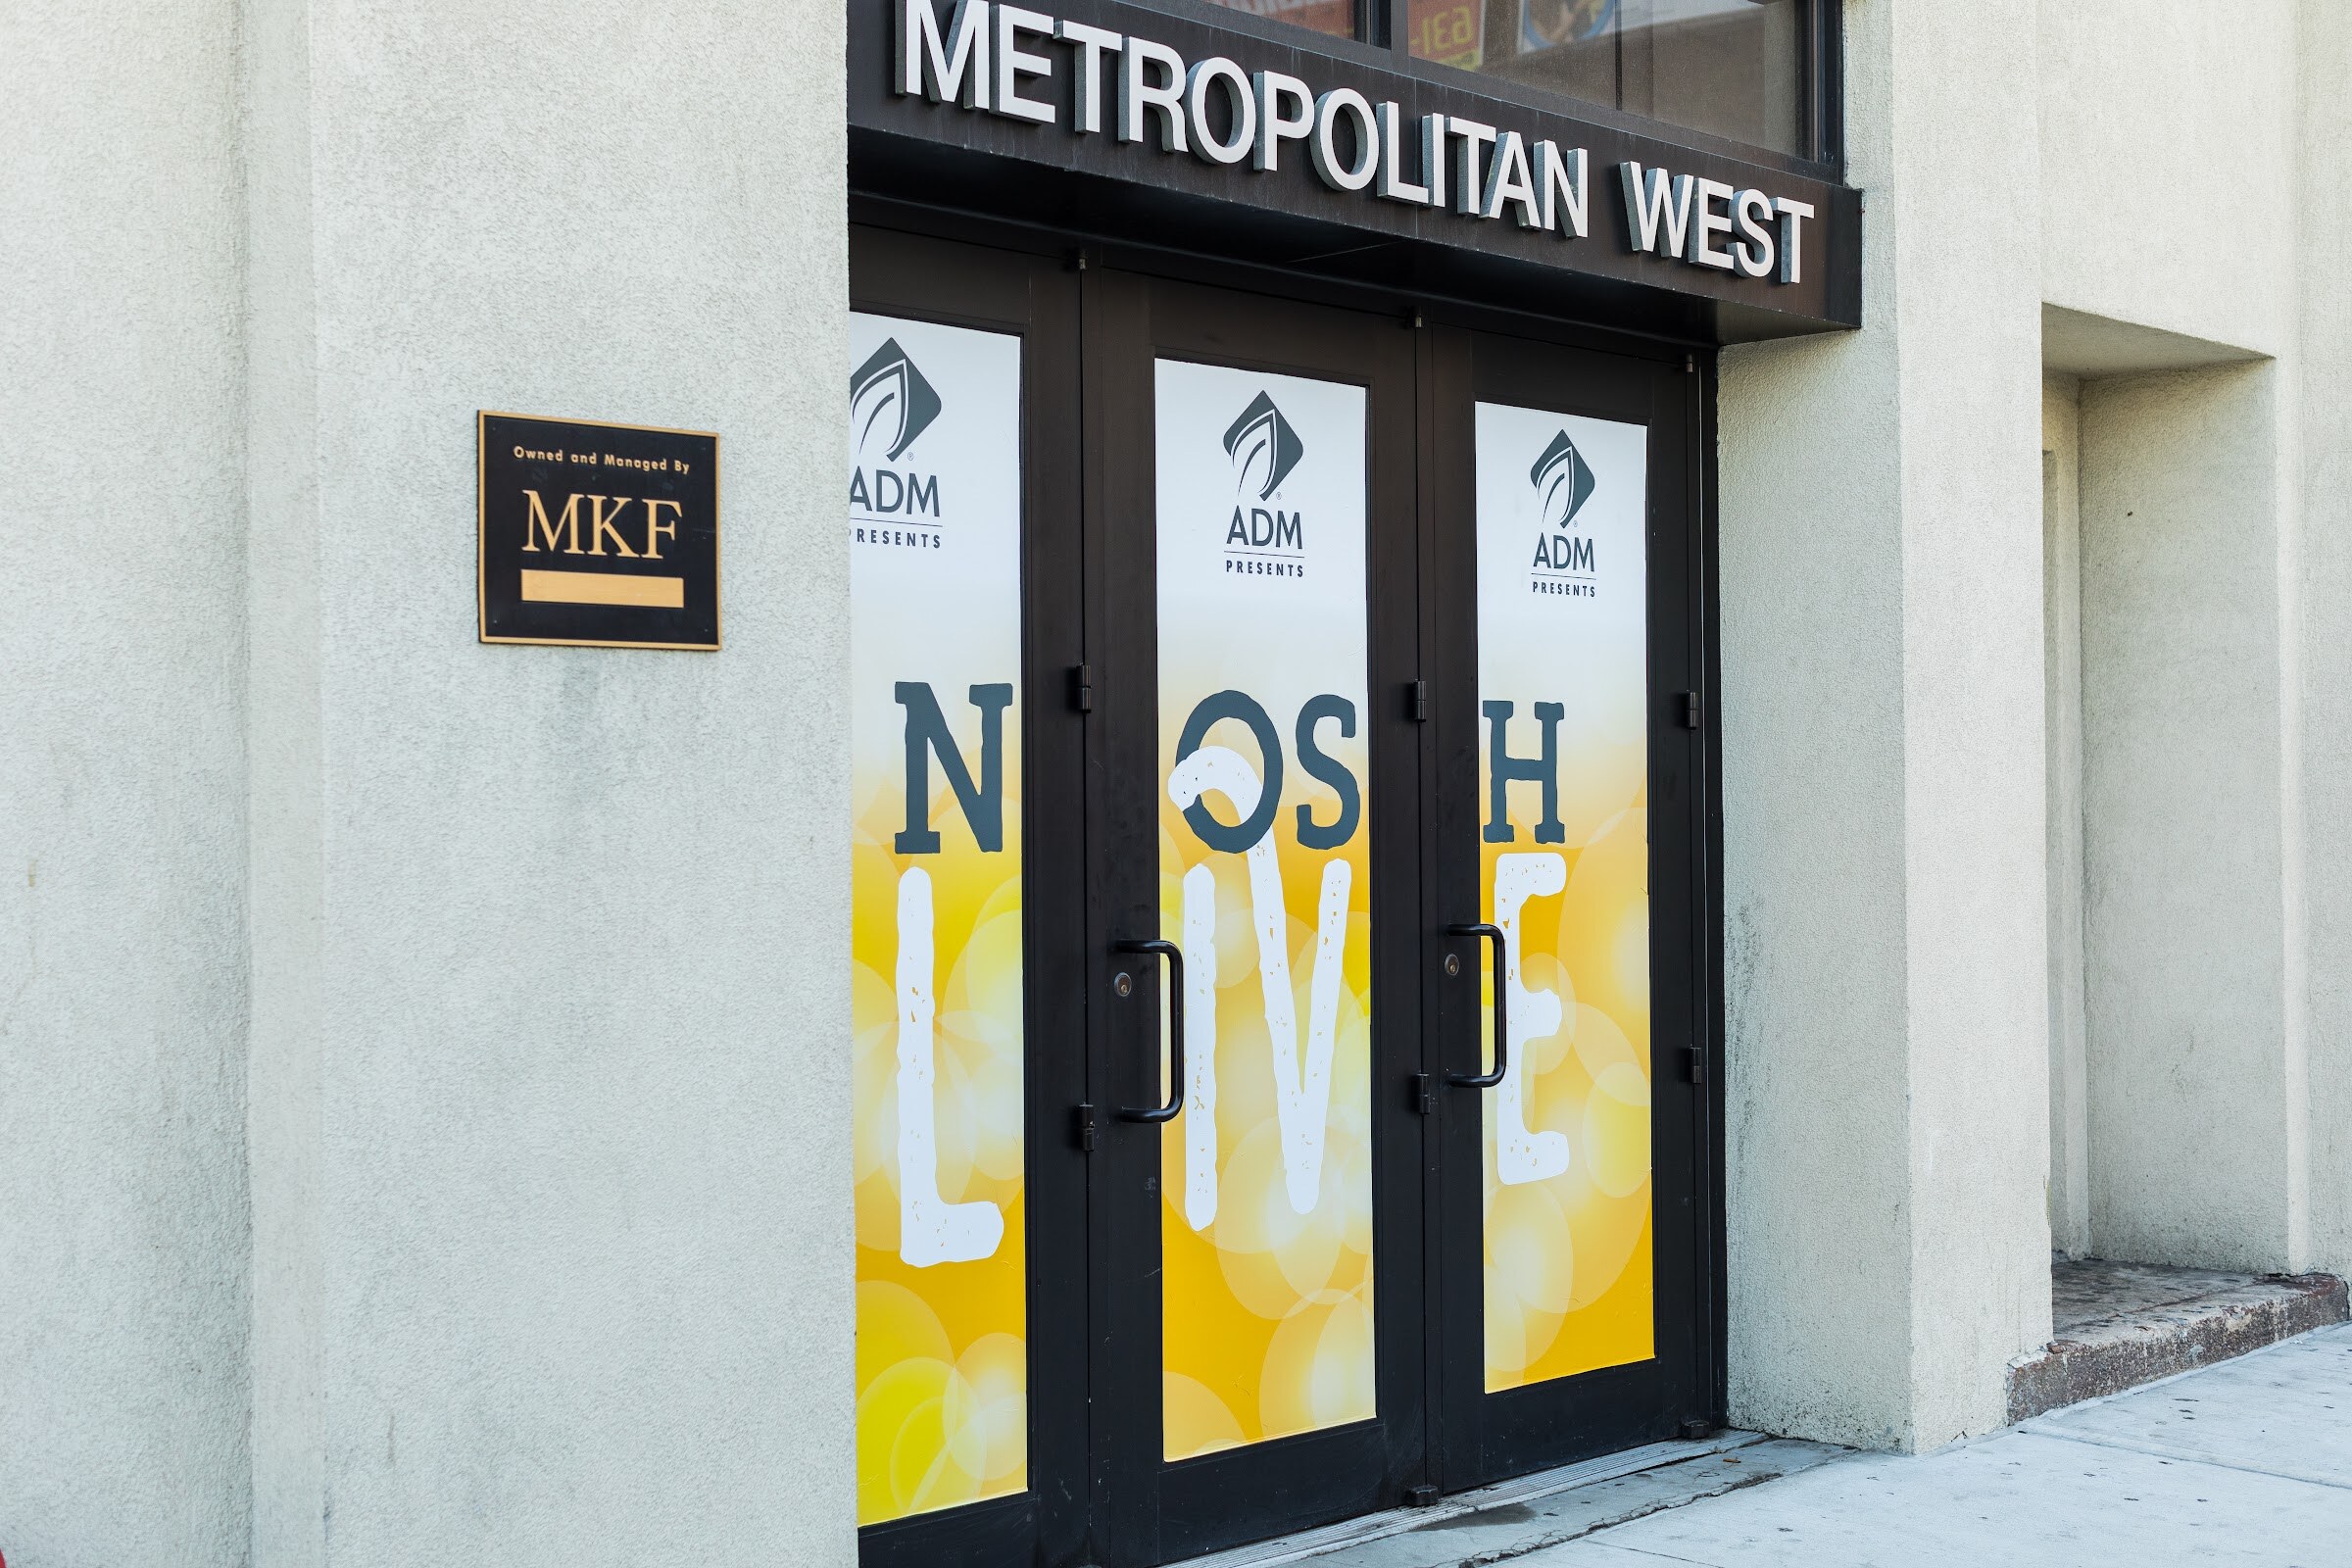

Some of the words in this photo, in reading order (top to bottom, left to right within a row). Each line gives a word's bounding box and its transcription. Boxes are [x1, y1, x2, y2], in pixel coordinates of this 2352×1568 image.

[894, 0, 1589, 239] METROPOLITAN
[1619, 160, 1815, 284] WEST
[513, 445, 564, 463] Owned
[570, 452, 598, 466] and
[604, 454, 667, 472] Managed
[674, 460, 690, 475] By
[849, 466, 941, 517] ADM
[521, 489, 683, 560] MKF
[849, 528, 941, 549] RESENTS
[1226, 505, 1303, 550] ADM
[1226, 560, 1304, 577] PRESENTS
[1533, 531, 1595, 572] ADM
[1533, 581, 1595, 598] PRESENTS
